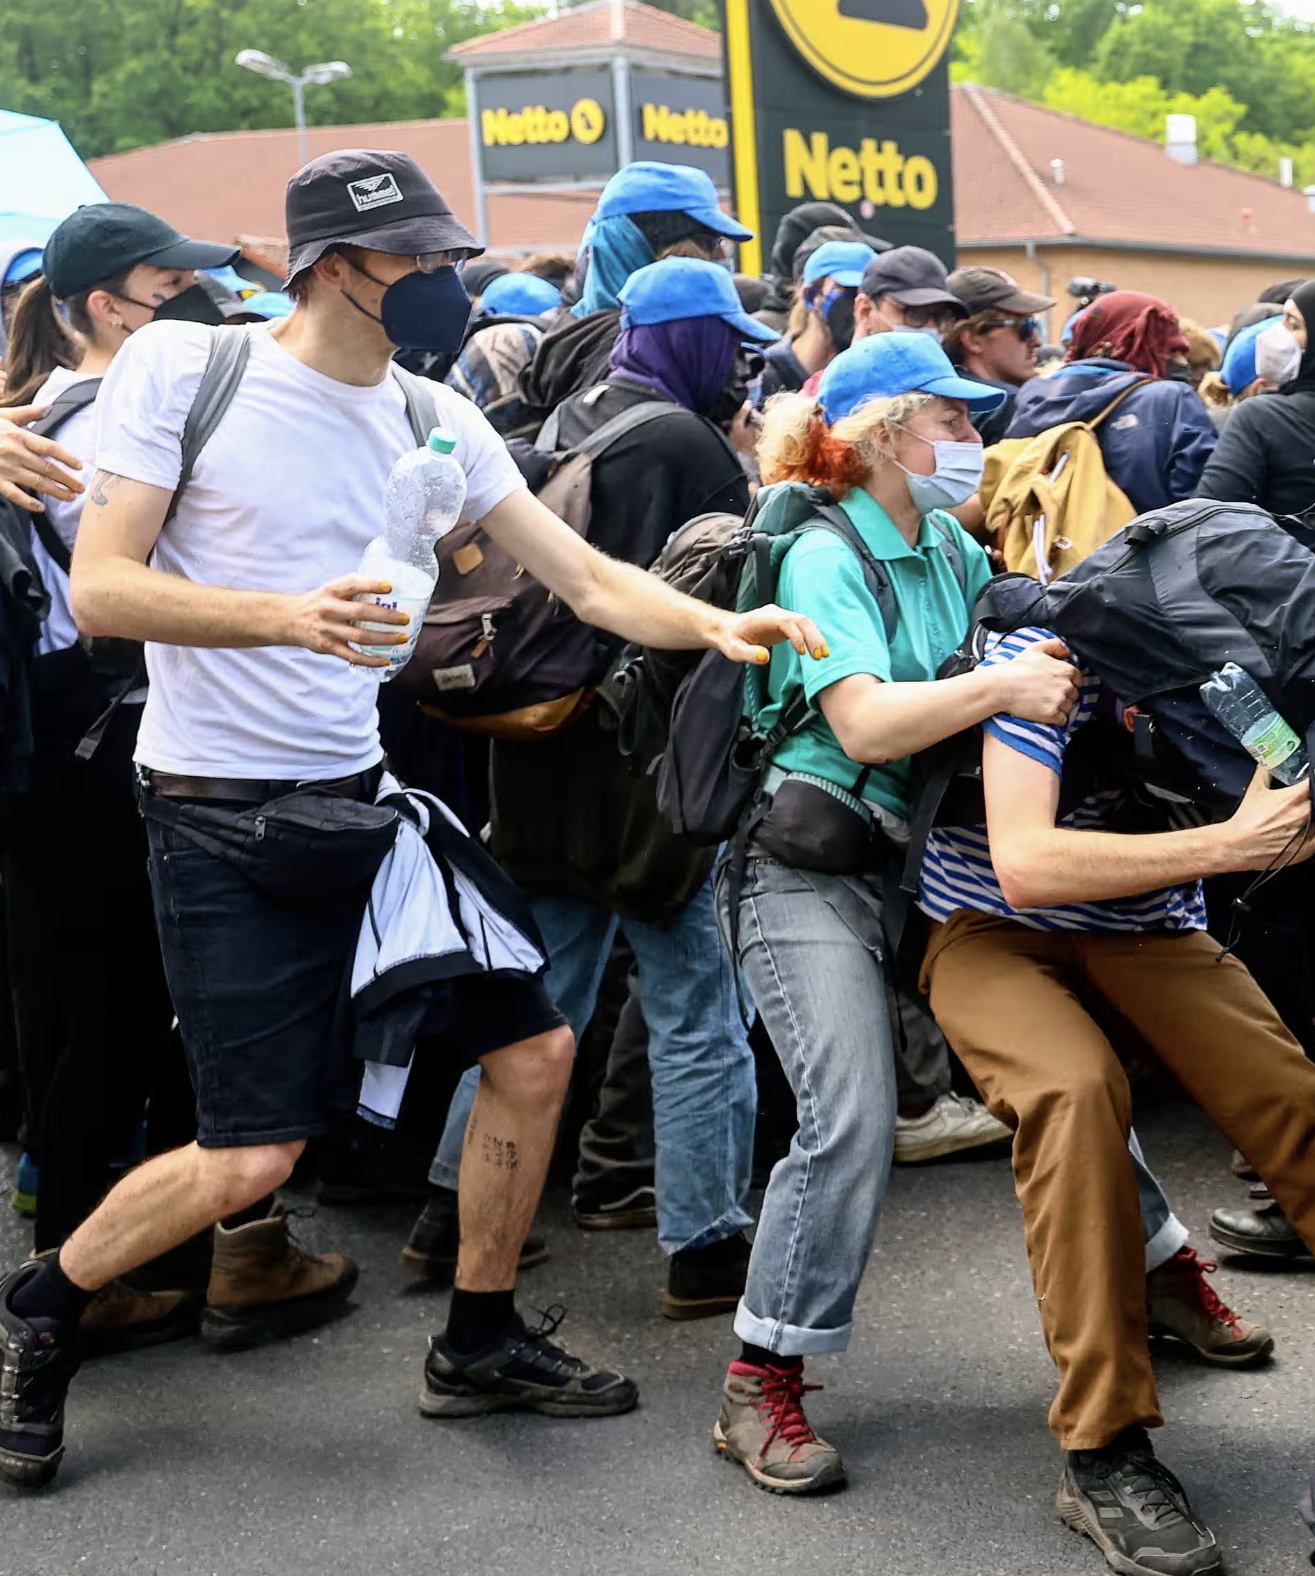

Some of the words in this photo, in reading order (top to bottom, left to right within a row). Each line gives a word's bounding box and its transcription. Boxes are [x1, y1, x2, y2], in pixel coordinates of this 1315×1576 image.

[482, 107, 570, 146] Netto
[642, 103, 729, 149] Netto
[783, 128, 938, 210] Netto
[356, 184, 397, 205] hummel
